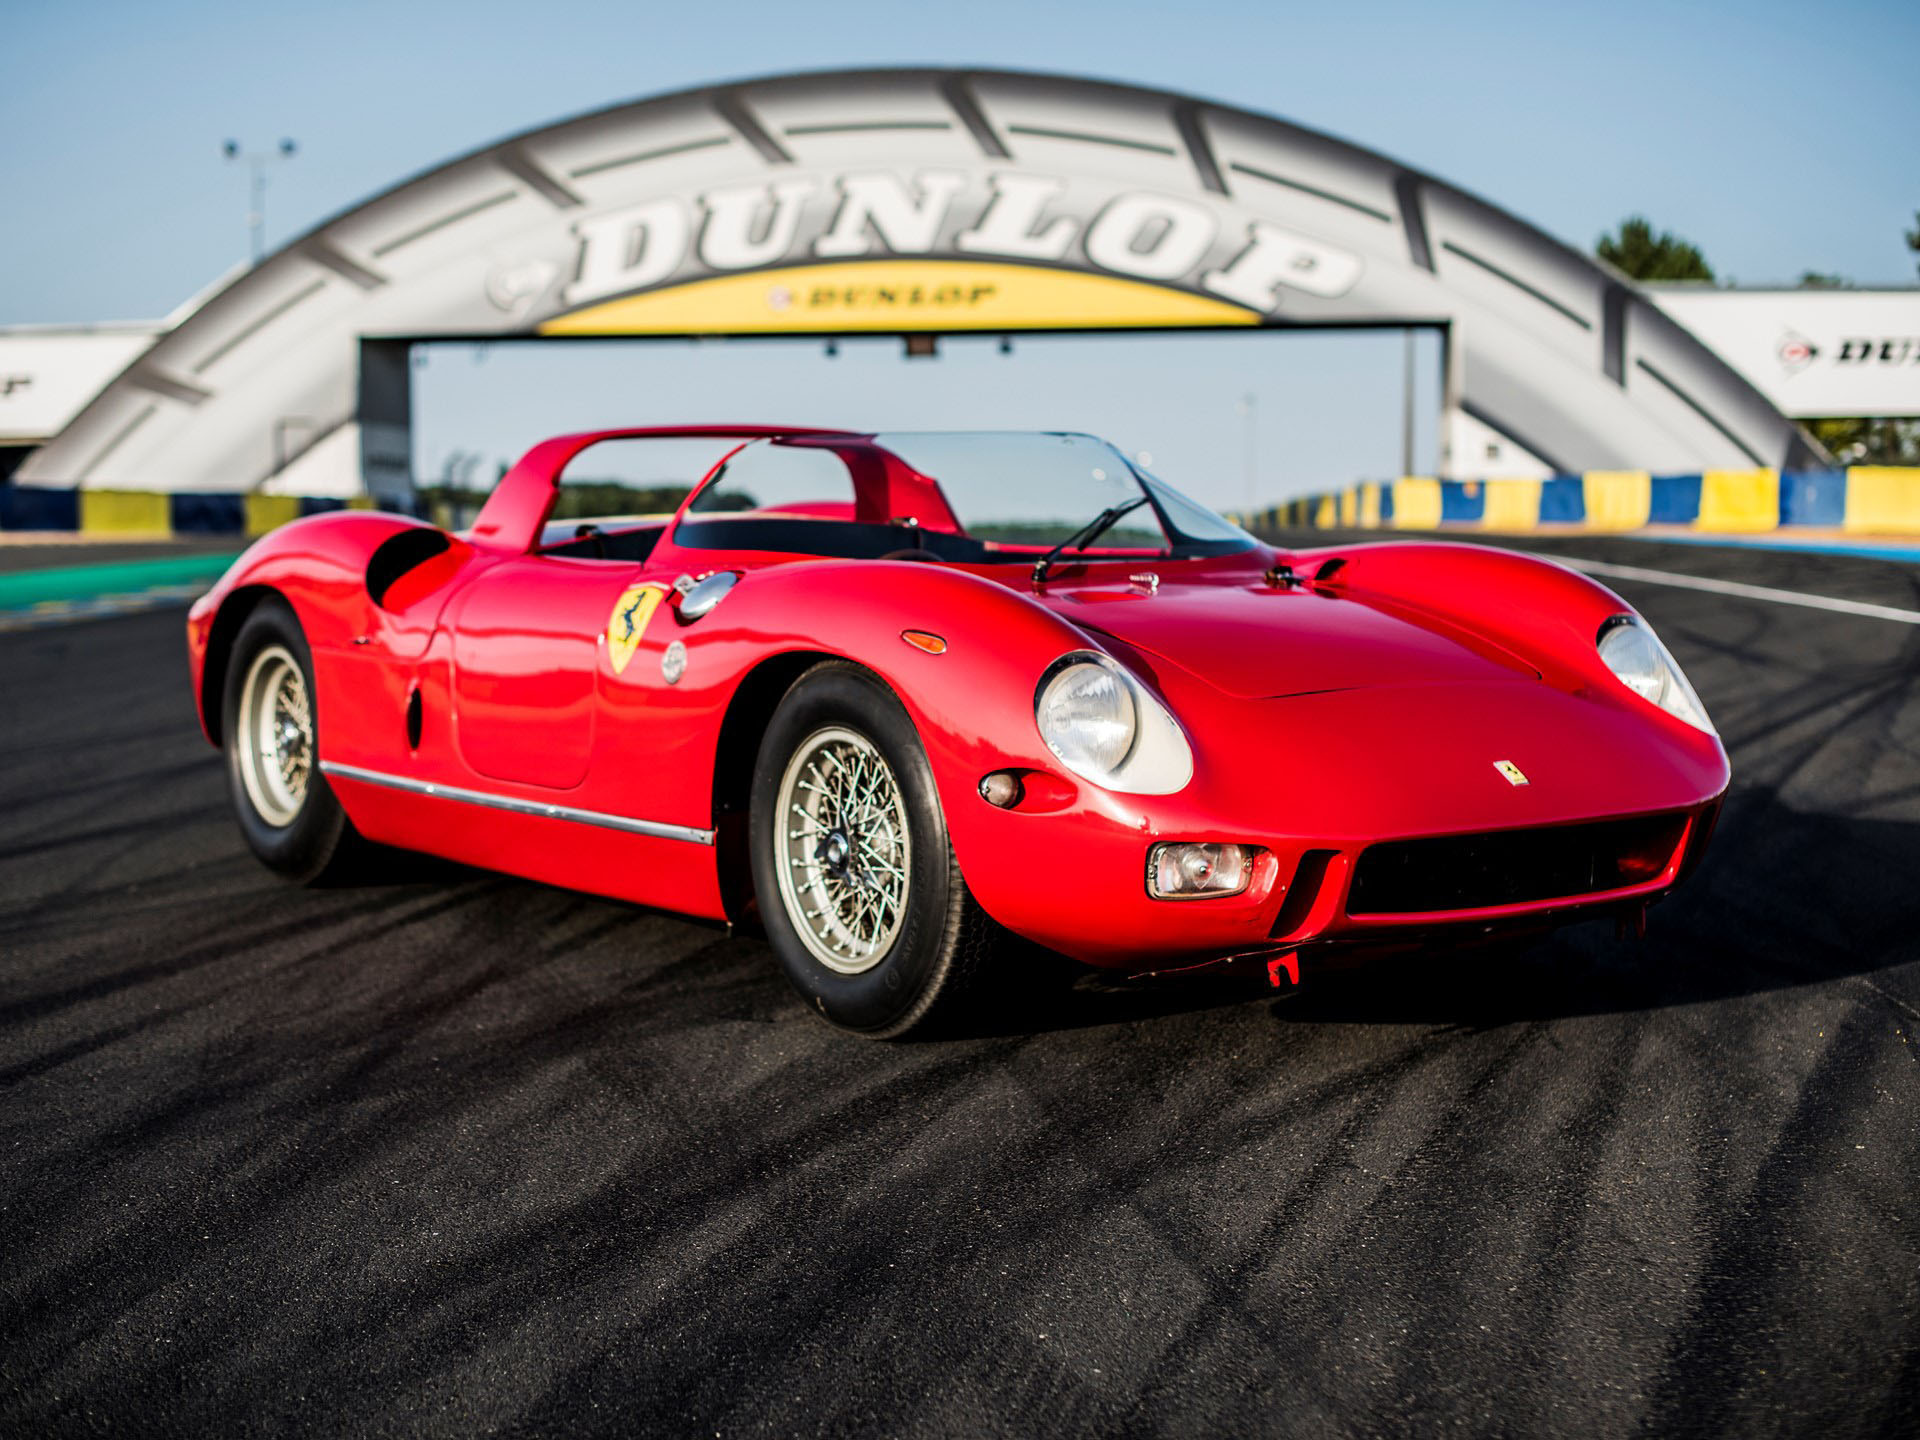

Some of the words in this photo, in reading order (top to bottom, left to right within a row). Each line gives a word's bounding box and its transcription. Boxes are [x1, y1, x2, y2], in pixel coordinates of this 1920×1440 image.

[564, 169, 1364, 316] DUNLOP
[809, 285, 997, 308] DUNLOP
[1837, 338, 1920, 362] DU
